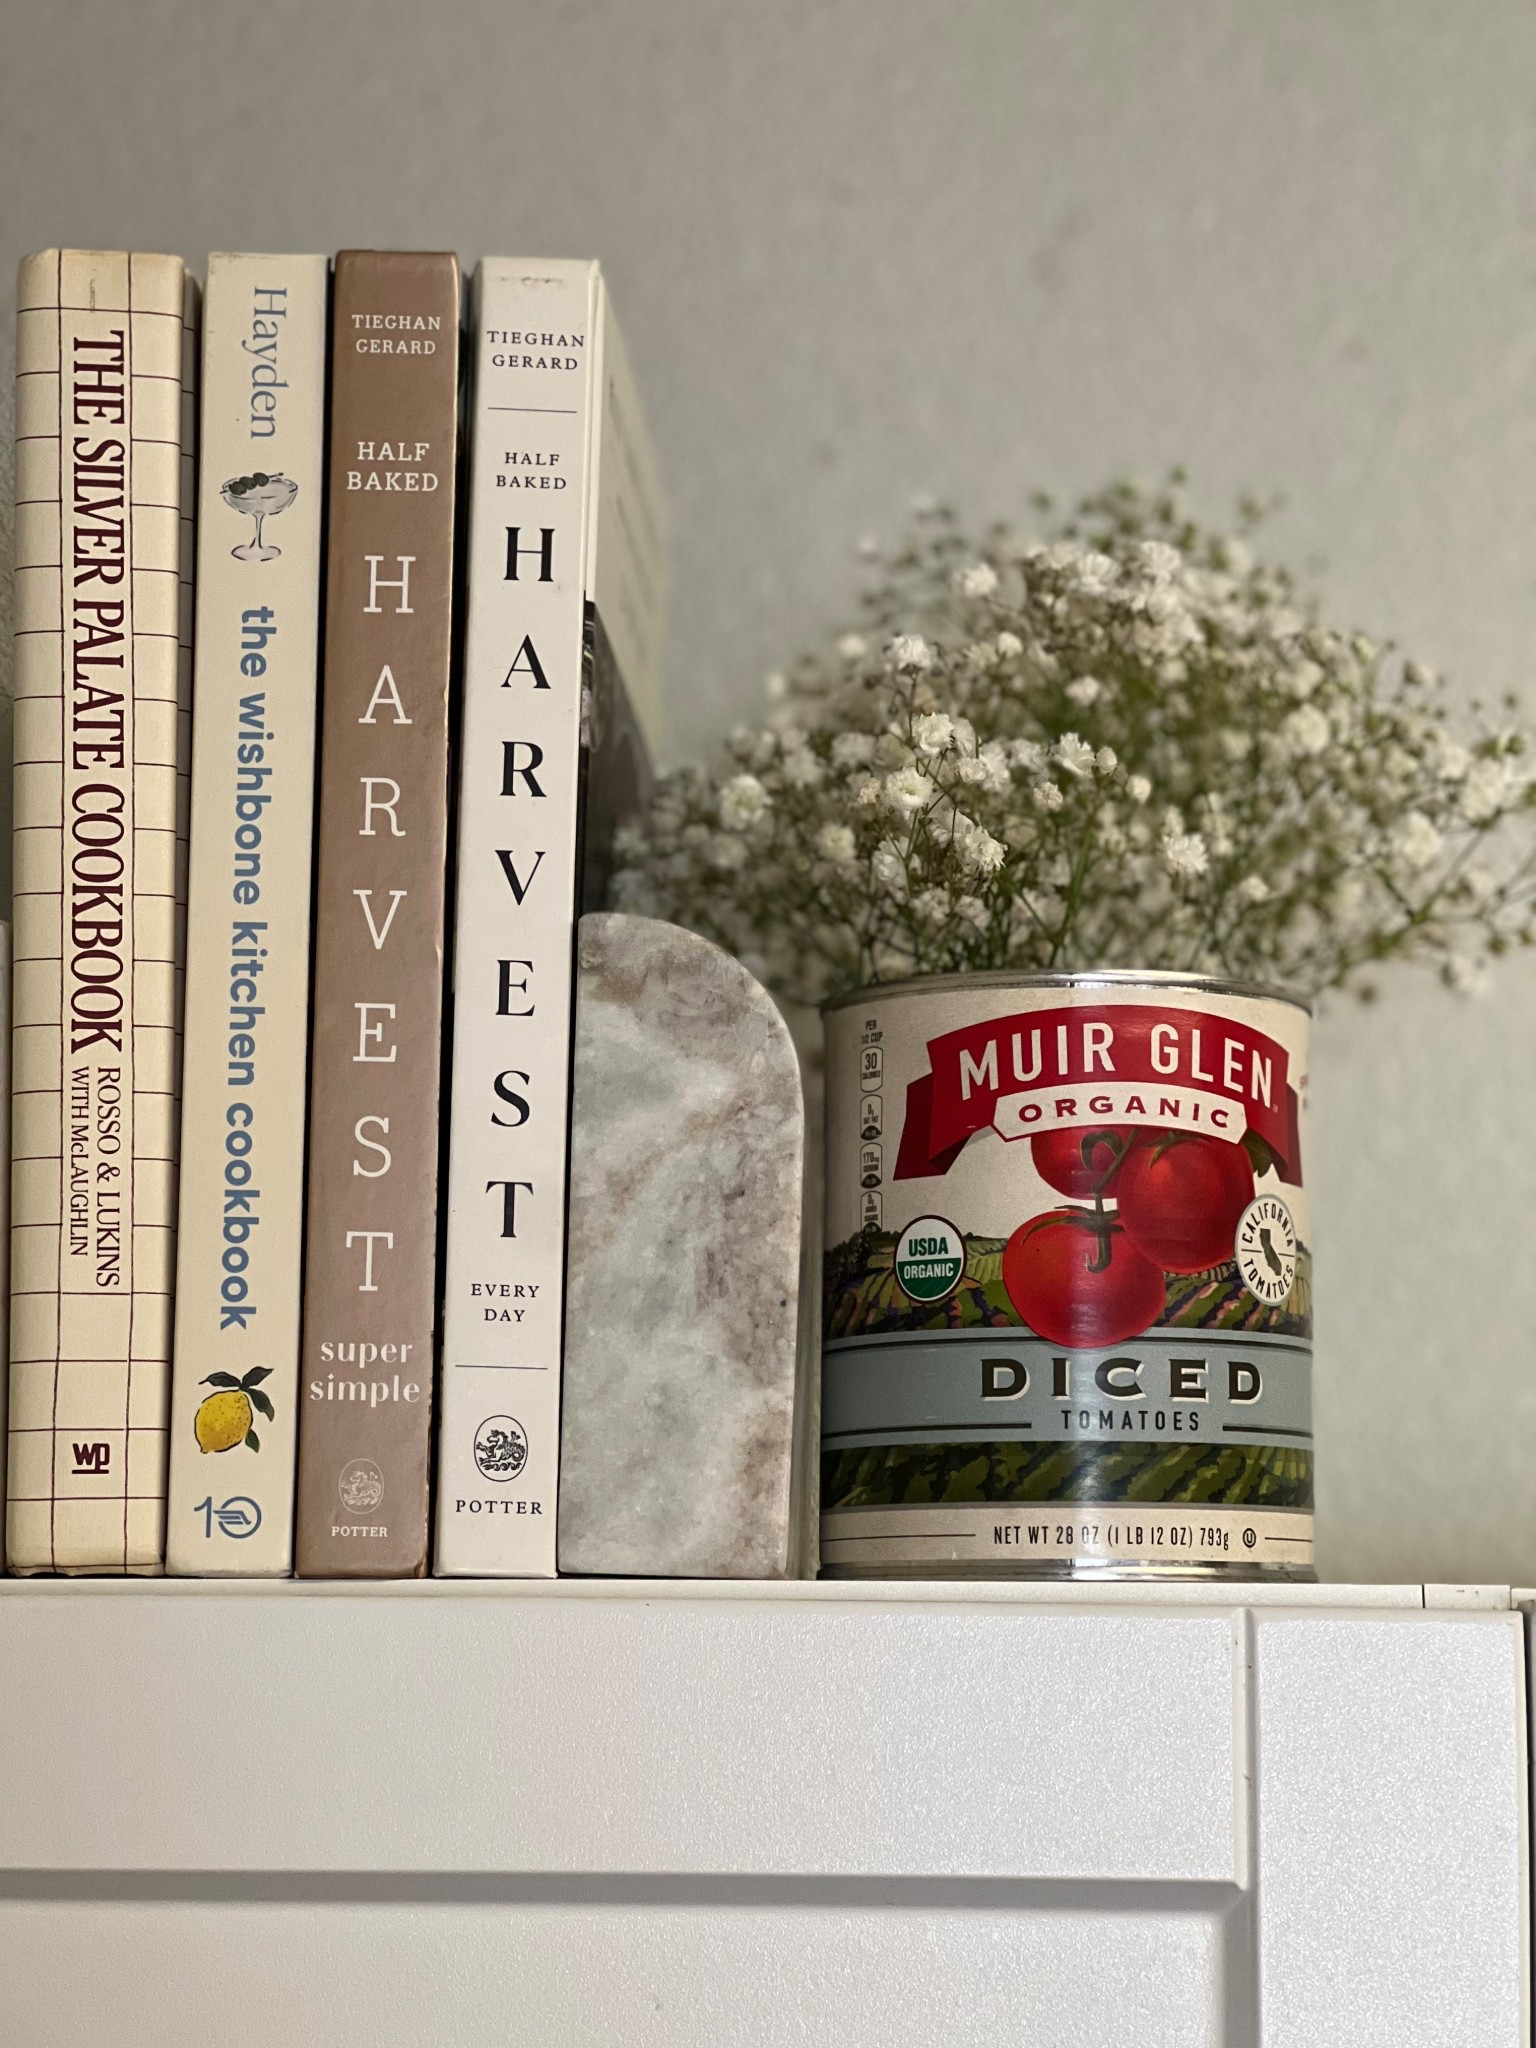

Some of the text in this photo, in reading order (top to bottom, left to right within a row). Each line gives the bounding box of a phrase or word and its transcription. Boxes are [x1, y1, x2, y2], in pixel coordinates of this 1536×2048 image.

[351, 314, 442, 331] TIEGHAN
[355, 338, 437, 356] GERARD
[486, 329, 586, 349] TIEGHAN
[242, 286, 290, 440] Hayden
[491, 353, 579, 372] GERARD
[356, 441, 430, 462] HALF
[504, 451, 560, 467] HALF
[346, 471, 439, 492] BAKED
[495, 474, 567, 491] BAKED
[70, 330, 126, 1055] THE SILVER PALATE COOKBOOK
[485, 526, 556, 1238] HARVEST
[346, 555, 416, 1292] HARVEST
[219, 605, 278, 1331] the wishbone kitchen cookbook
[865, 1020, 877, 1031] PER
[870, 1031, 884, 1043] CUP
[865, 1052, 878, 1070] 30
[959, 1022, 1272, 1109] MUIR GLEN
[1018, 1095, 1230, 1129] ORGANIC
[70, 1066, 89, 1256] WITH McLAUGHLIN
[96, 1066, 121, 1288] ROSSO & LUKINS
[1241, 1202, 1294, 1248] CALIFORNIA
[908, 1236, 949, 1257] USDA
[903, 1262, 954, 1280] ORGANIC
[1243, 1258, 1294, 1299] TOMATOES
[470, 1283, 541, 1299] EVERY
[483, 1308, 526, 1323] DAY
[319, 1340, 414, 1370] super
[309, 1372, 421, 1408] simple
[979, 1357, 1263, 1405] DICED
[1061, 1409, 1200, 1432] TOMATOES
[455, 1499, 544, 1515] POTTER
[331, 1525, 388, 1539] POTTER
[994, 1525, 1021, 1544] NET
[1028, 1525, 1049, 1545] WT
[1056, 1525, 1074, 1545] 28
[1081, 1525, 1099, 1545] OZ
[1107, 1524, 1120, 1547] (1
[1126, 1526, 1144, 1545] LB
[1150, 1526, 1164, 1546] 12
[1170, 1526, 1193, 1547] OZ)
[1199, 1527, 1229, 1550] 793g
